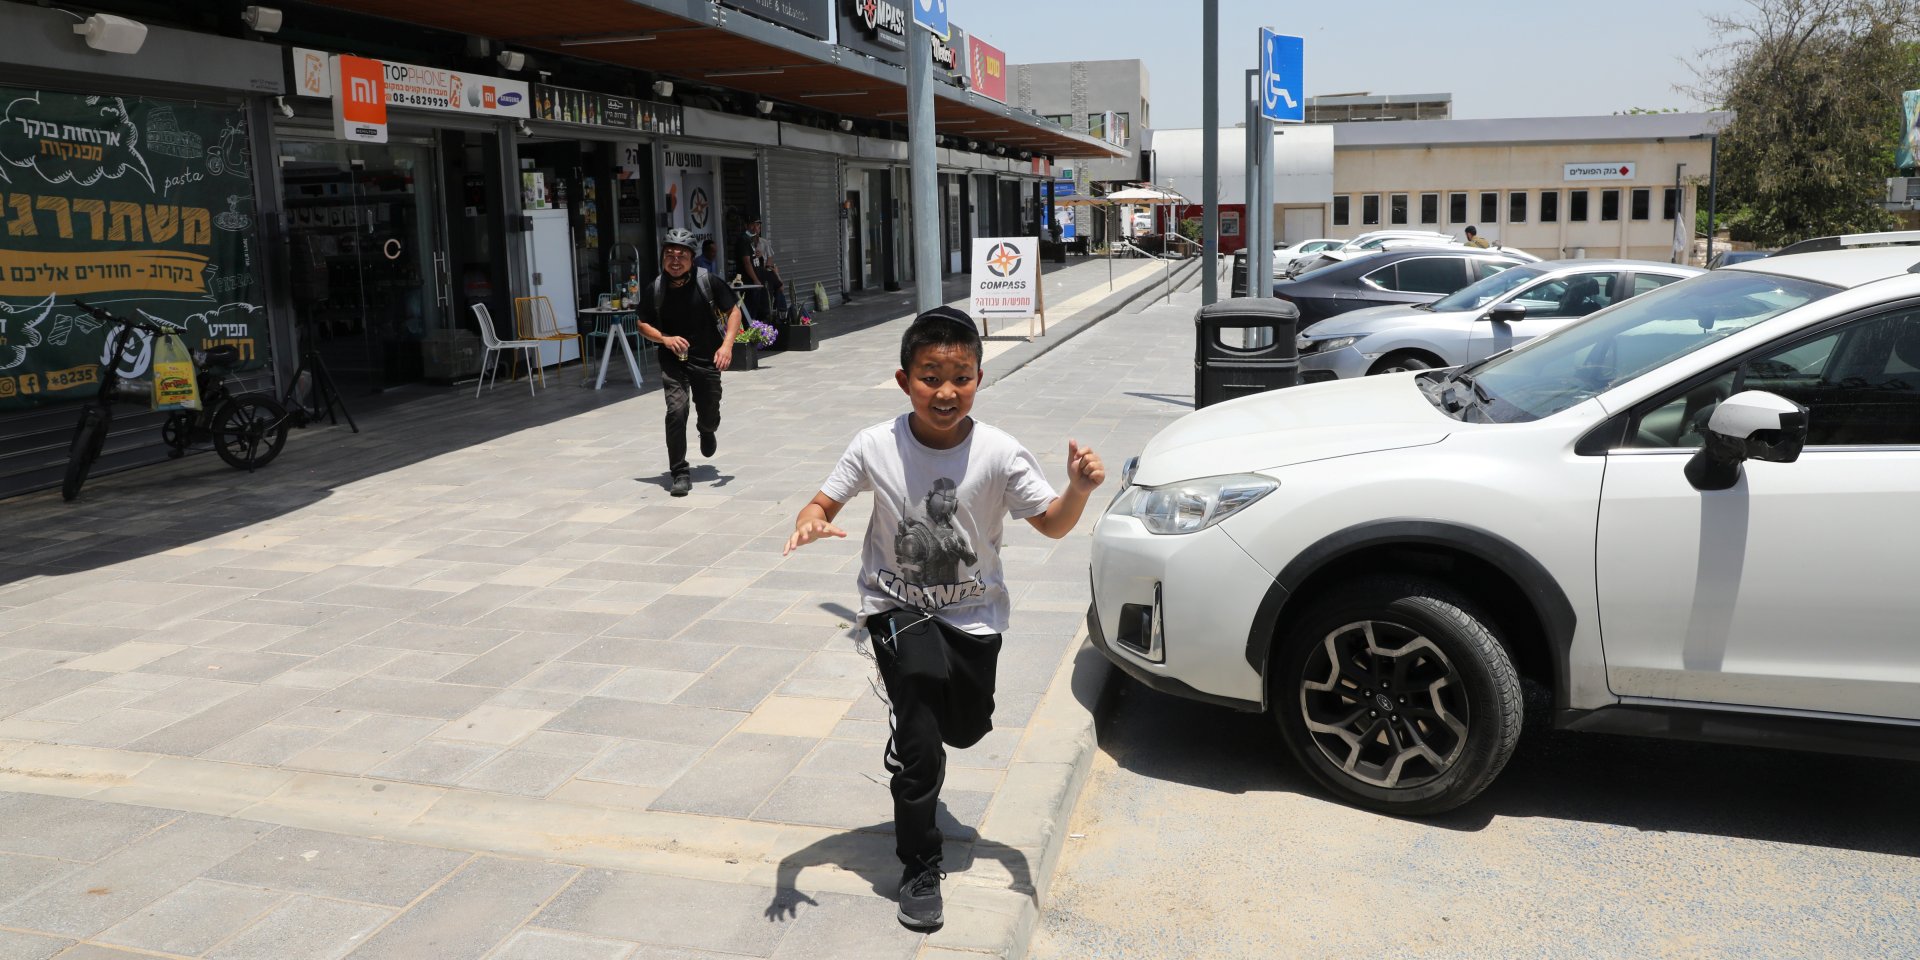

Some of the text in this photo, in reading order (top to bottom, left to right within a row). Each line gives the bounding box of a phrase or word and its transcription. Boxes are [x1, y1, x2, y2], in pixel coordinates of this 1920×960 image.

[383, 64, 447, 87] TOPPHONE
[393, 92, 448, 107] 08-6829929
[500, 95, 520, 103] SAMSUNG
[15, 117, 121, 147] ארוחות בוקר
[39, 139, 104, 161] מפנקות
[665, 152, 702, 168] מחפש/ת
[1569, 168, 1617, 176] בנק הפועלים
[164, 166, 204, 198] pasta
[10, 262, 69, 282] אליכם
[75, 264, 132, 280] חוזרים
[149, 264, 193, 283] בקרוב
[980, 281, 1027, 290] COMPASS
[1002, 297, 1031, 306] מחפש/ת
[208, 323, 248, 337] תפריט
